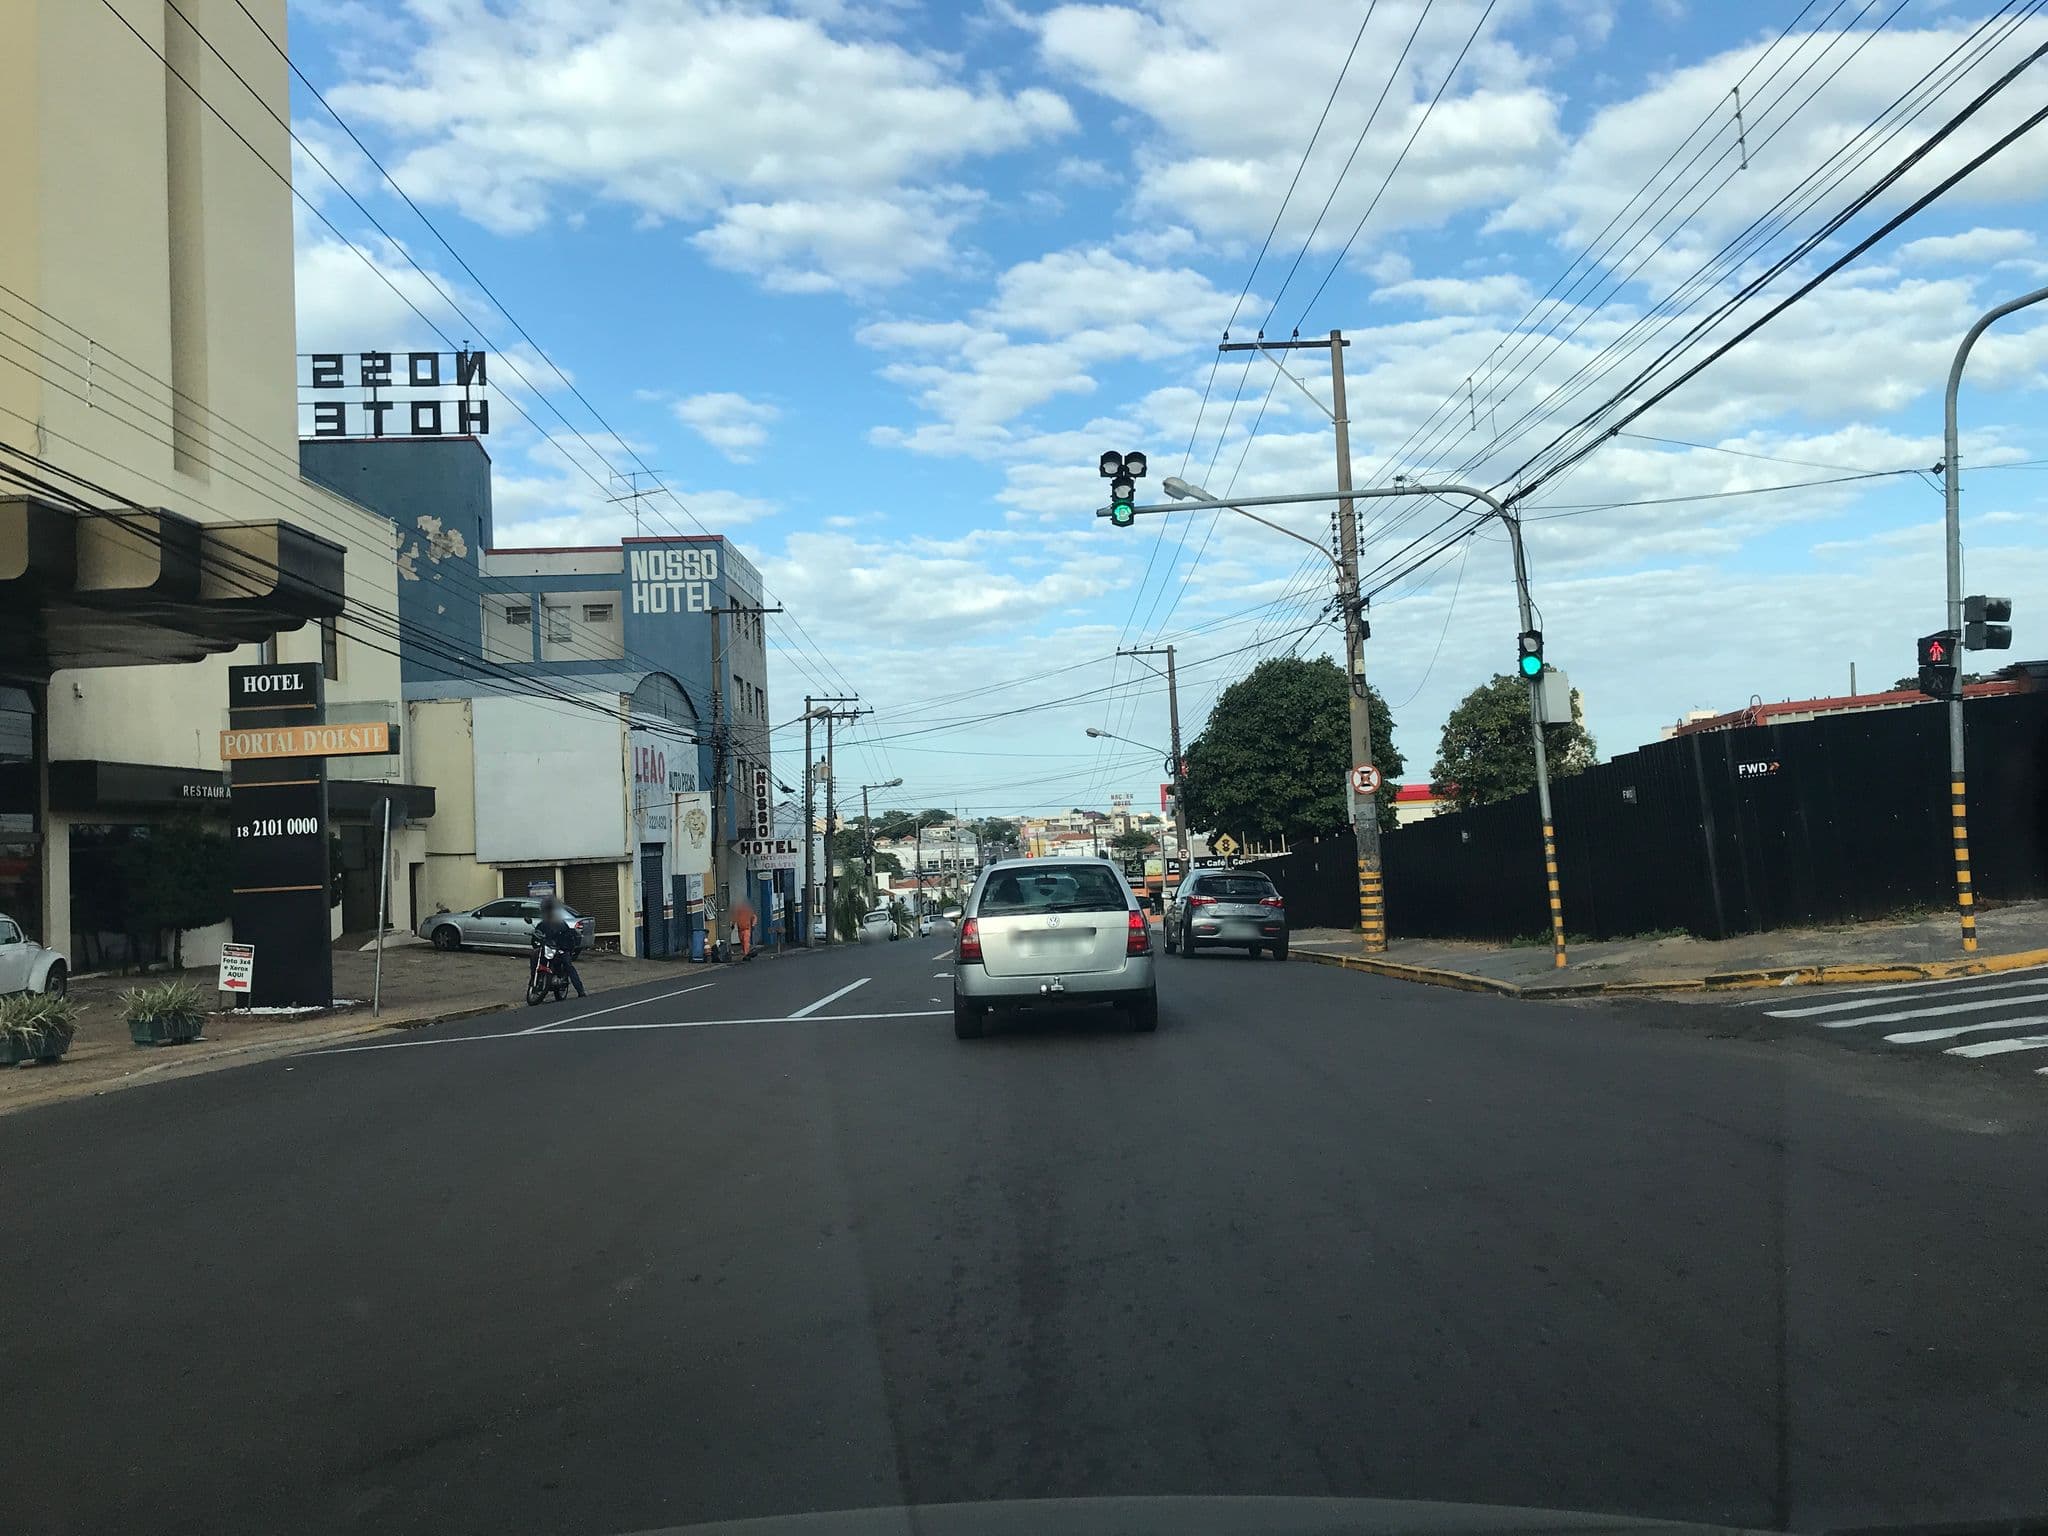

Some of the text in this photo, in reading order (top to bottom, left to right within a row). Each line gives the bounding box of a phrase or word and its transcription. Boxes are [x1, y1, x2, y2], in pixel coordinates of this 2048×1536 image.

[630, 549, 718, 581] NOSSO
[632, 581, 712, 613] HOTEL
[243, 674, 304, 693] HOTEL
[224, 731, 297, 756] PORTAL
[1739, 762, 1768, 774] FWD
[756, 771, 768, 838] NOSSO
[237, 817, 318, 838] 18 2101 0000
[740, 840, 797, 855] HOTEL
